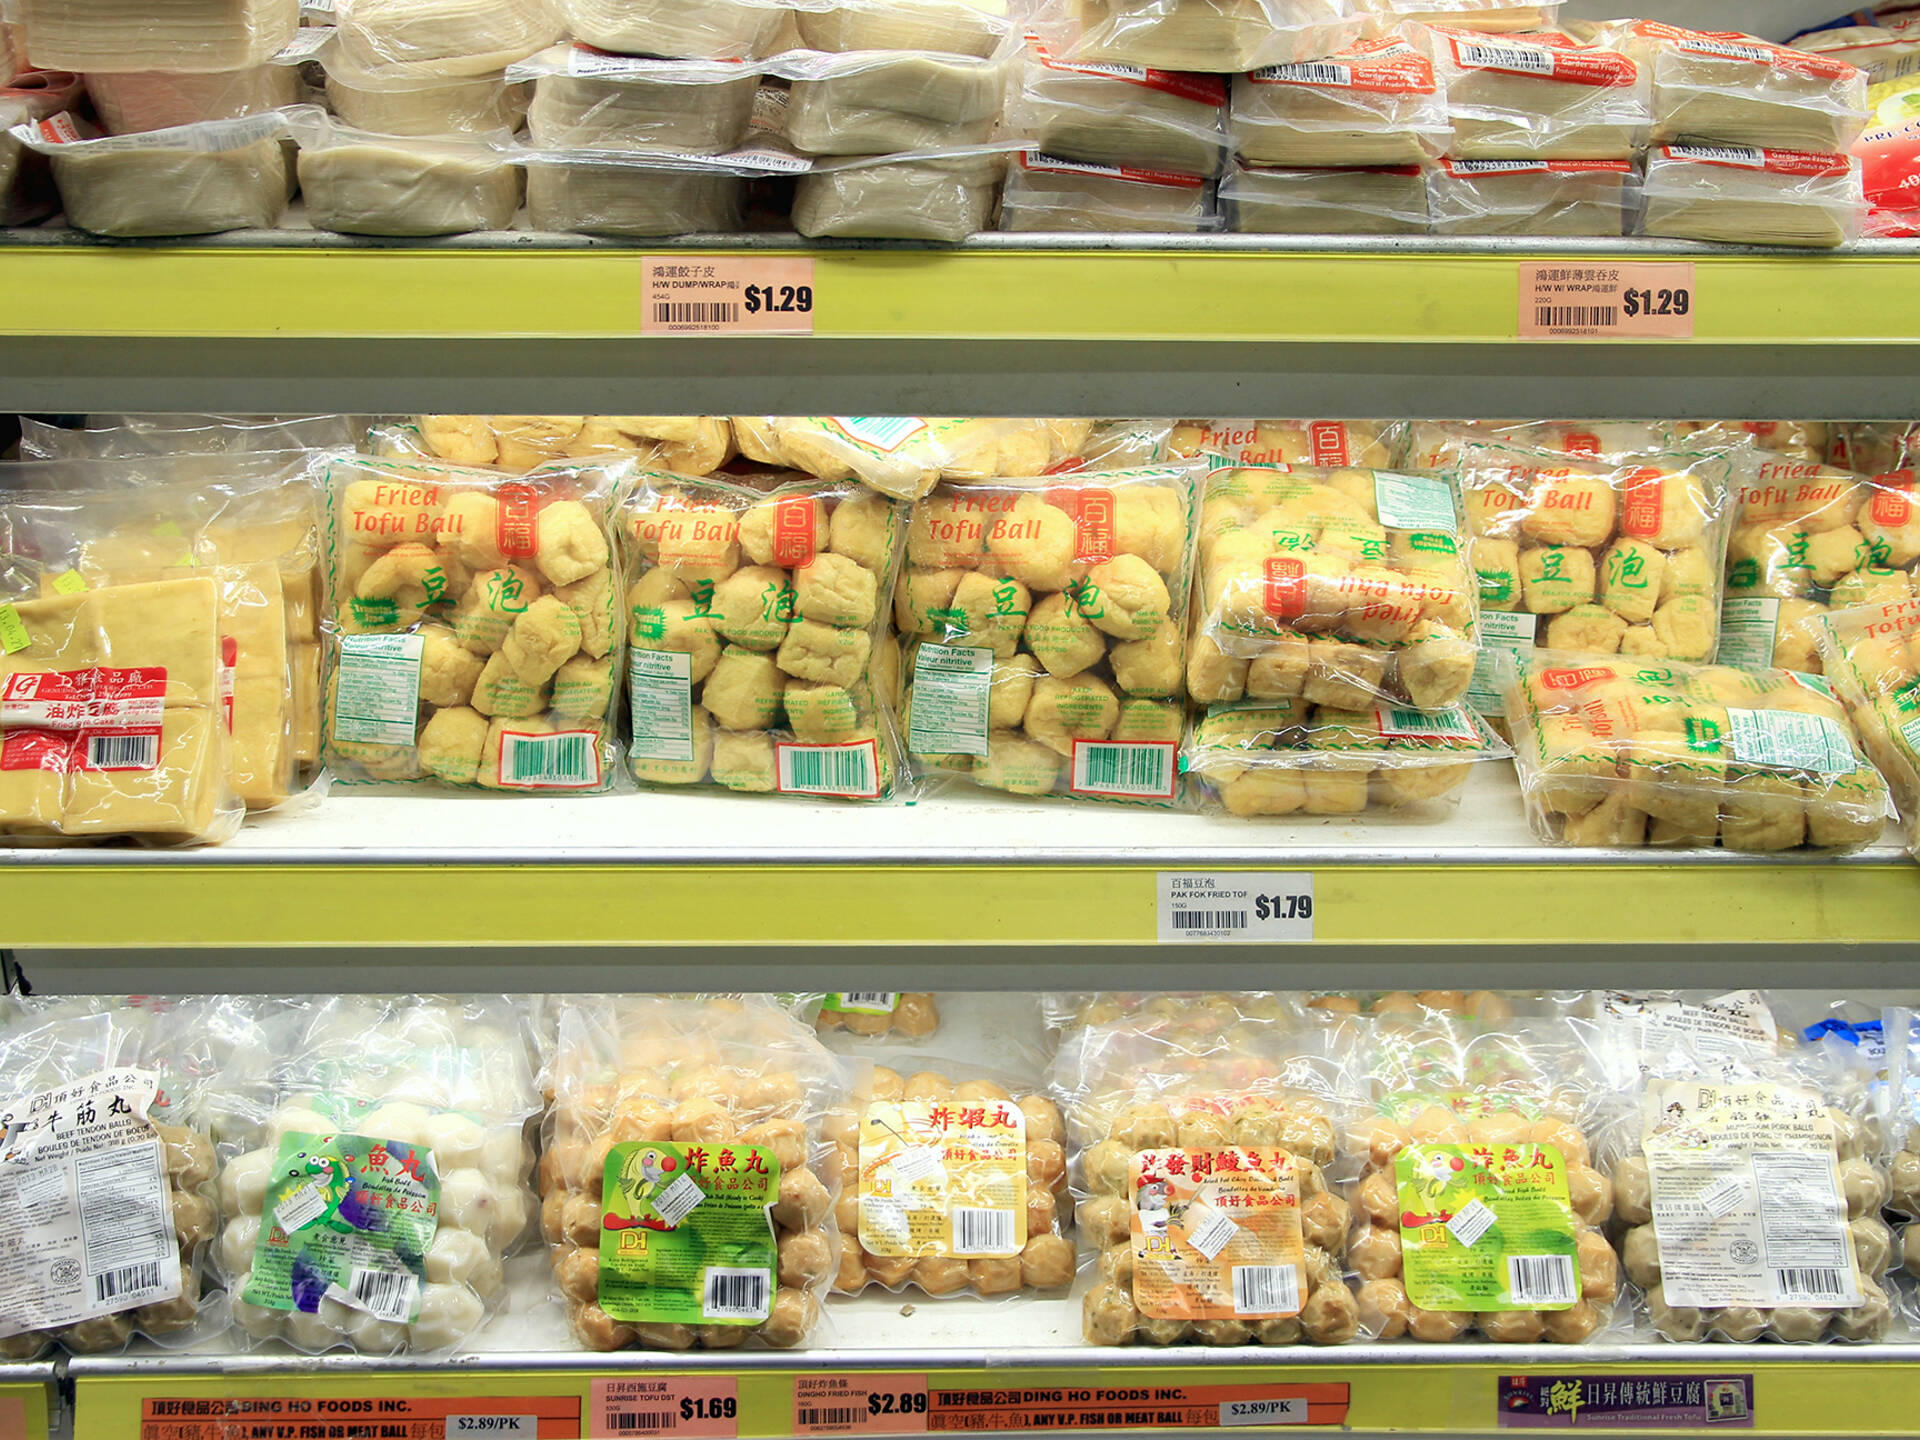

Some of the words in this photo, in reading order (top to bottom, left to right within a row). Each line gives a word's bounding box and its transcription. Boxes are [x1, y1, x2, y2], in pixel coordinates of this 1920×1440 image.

[652, 266, 715, 278] 鴻運餃子皮
[652, 281, 670, 289] H/W
[744, 284, 813, 314] $1.29
[1623, 287, 1689, 317] $1.29
[1200, 427, 1259, 446] Fried
[1759, 462, 1820, 479] Fried
[374, 485, 439, 506] Fried
[952, 492, 1017, 513] Fried
[1545, 490, 1592, 510] Ball
[1740, 486, 1787, 504] Tofu
[1794, 484, 1841, 501] Ball
[353, 512, 405, 535] Tofu
[415, 513, 463, 534] Ball
[634, 520, 682, 541] Tofu
[693, 520, 740, 542] Ball
[779, 505, 808, 559] 百福
[930, 519, 986, 540] Tofu
[992, 519, 1041, 540] Ball
[1776, 532, 1895, 576] 豆泡
[1531, 544, 1648, 588] 豆泡
[415, 566, 529, 613] 豆泡
[985, 575, 1105, 620] 豆泡
[683, 578, 803, 623] 豆泡
[651, 653, 673, 661] Facts
[951, 648, 975, 657] Facts
[1171, 877, 1215, 889] 百福豆泡
[1255, 893, 1312, 921] $1.79
[41, 1095, 132, 1132] 牛筋丸
[928, 1104, 1017, 1132] 炸蝦丸
[56, 1130, 75, 1140] BEEF
[76, 1124, 107, 1136] TENDON
[109, 1119, 132, 1130] BALLS
[38, 1141, 69, 1154] BOULES
[70, 1139, 80, 1147] DE
[81, 1132, 111, 1145] TENDON
[113, 1128, 124, 1138] DE
[360, 1143, 426, 1182] 魚丸
[685, 1147, 769, 1174] 炸魚丸
[690, 1175, 769, 1191] 好食品公司
[1473, 1171, 1555, 1187] 頂好食品公司
[1215, 1193, 1296, 1207] 頂好食品公司
[938, 1391, 1021, 1406] 頂好食品公司
[1023, 1390, 1062, 1402] DING
[1068, 1390, 1090, 1401] HO
[1096, 1389, 1149, 1401] FOODS
[1155, 1389, 1187, 1400] INC.
[1546, 1379, 1586, 1424] 鮮
[1587, 1380, 1701, 1405] 日昇傳統鮮豆腐
[288, 1401, 311, 1412] HO
[317, 1400, 373, 1412] FOODS
[379, 1400, 412, 1412] INC.
[680, 1396, 737, 1421] $1.69
[868, 1392, 927, 1416] $2.89
[1231, 1401, 1291, 1416] $2.89/PK
[458, 1417, 520, 1430] $2.89/PK
[1033, 1413, 1055, 1426] ANY
[1058, 1412, 1078, 1425] V.P.
[1080, 1412, 1104, 1425] FISH
[1107, 1412, 1122, 1425] OR
[1125, 1411, 1154, 1424] MEAT
[1157, 1411, 1183, 1423] BALL
[1587, 1413, 1615, 1421] Sunrise
[1617, 1413, 1659, 1421] Traditional
[1661, 1413, 1682, 1421] Fresh
[252, 1426, 274, 1439] ANY
[300, 1425, 326, 1438] FISH
[329, 1425, 344, 1438] OR
[347, 1425, 377, 1438] MEAT
[381, 1424, 408, 1437] BALL
